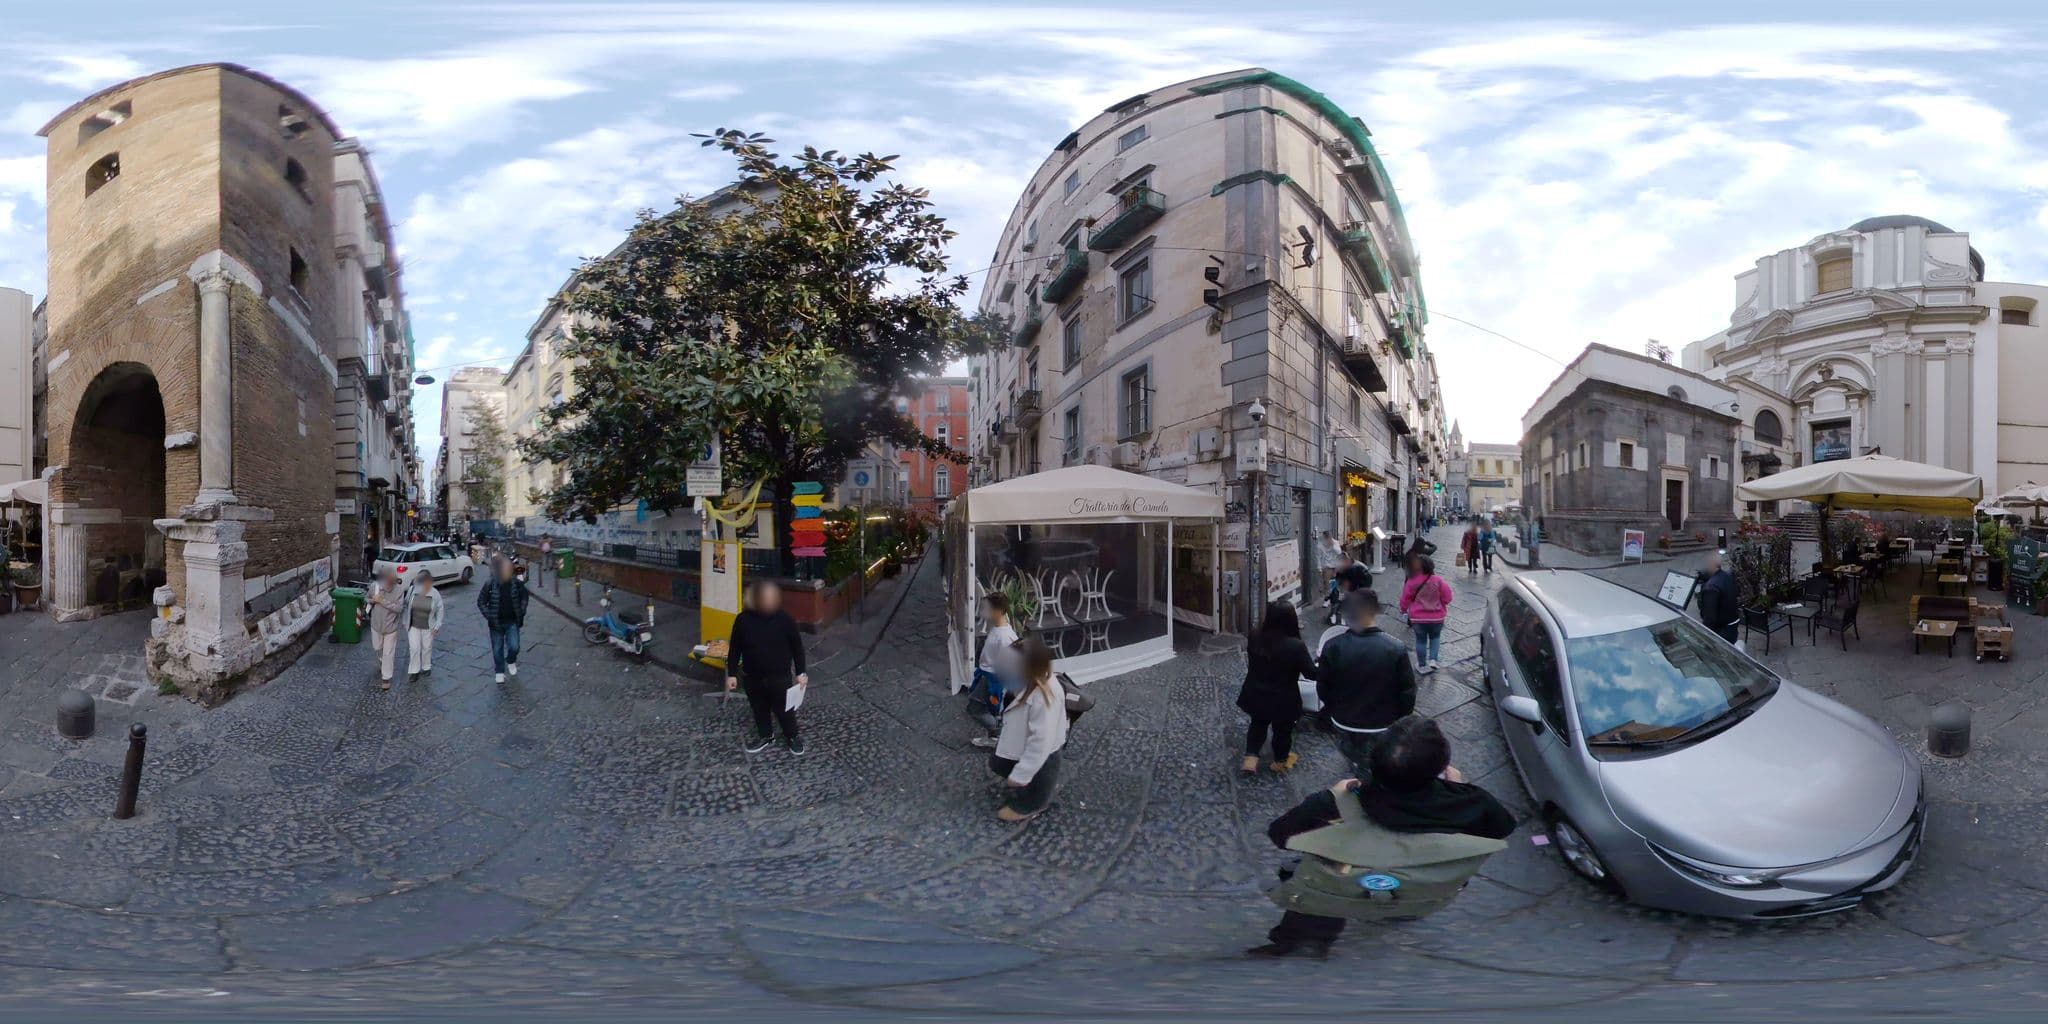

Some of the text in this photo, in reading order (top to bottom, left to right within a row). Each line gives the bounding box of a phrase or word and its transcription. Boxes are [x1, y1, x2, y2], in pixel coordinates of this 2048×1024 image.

[1069, 496, 1169, 514] Trattoria da Carmela
